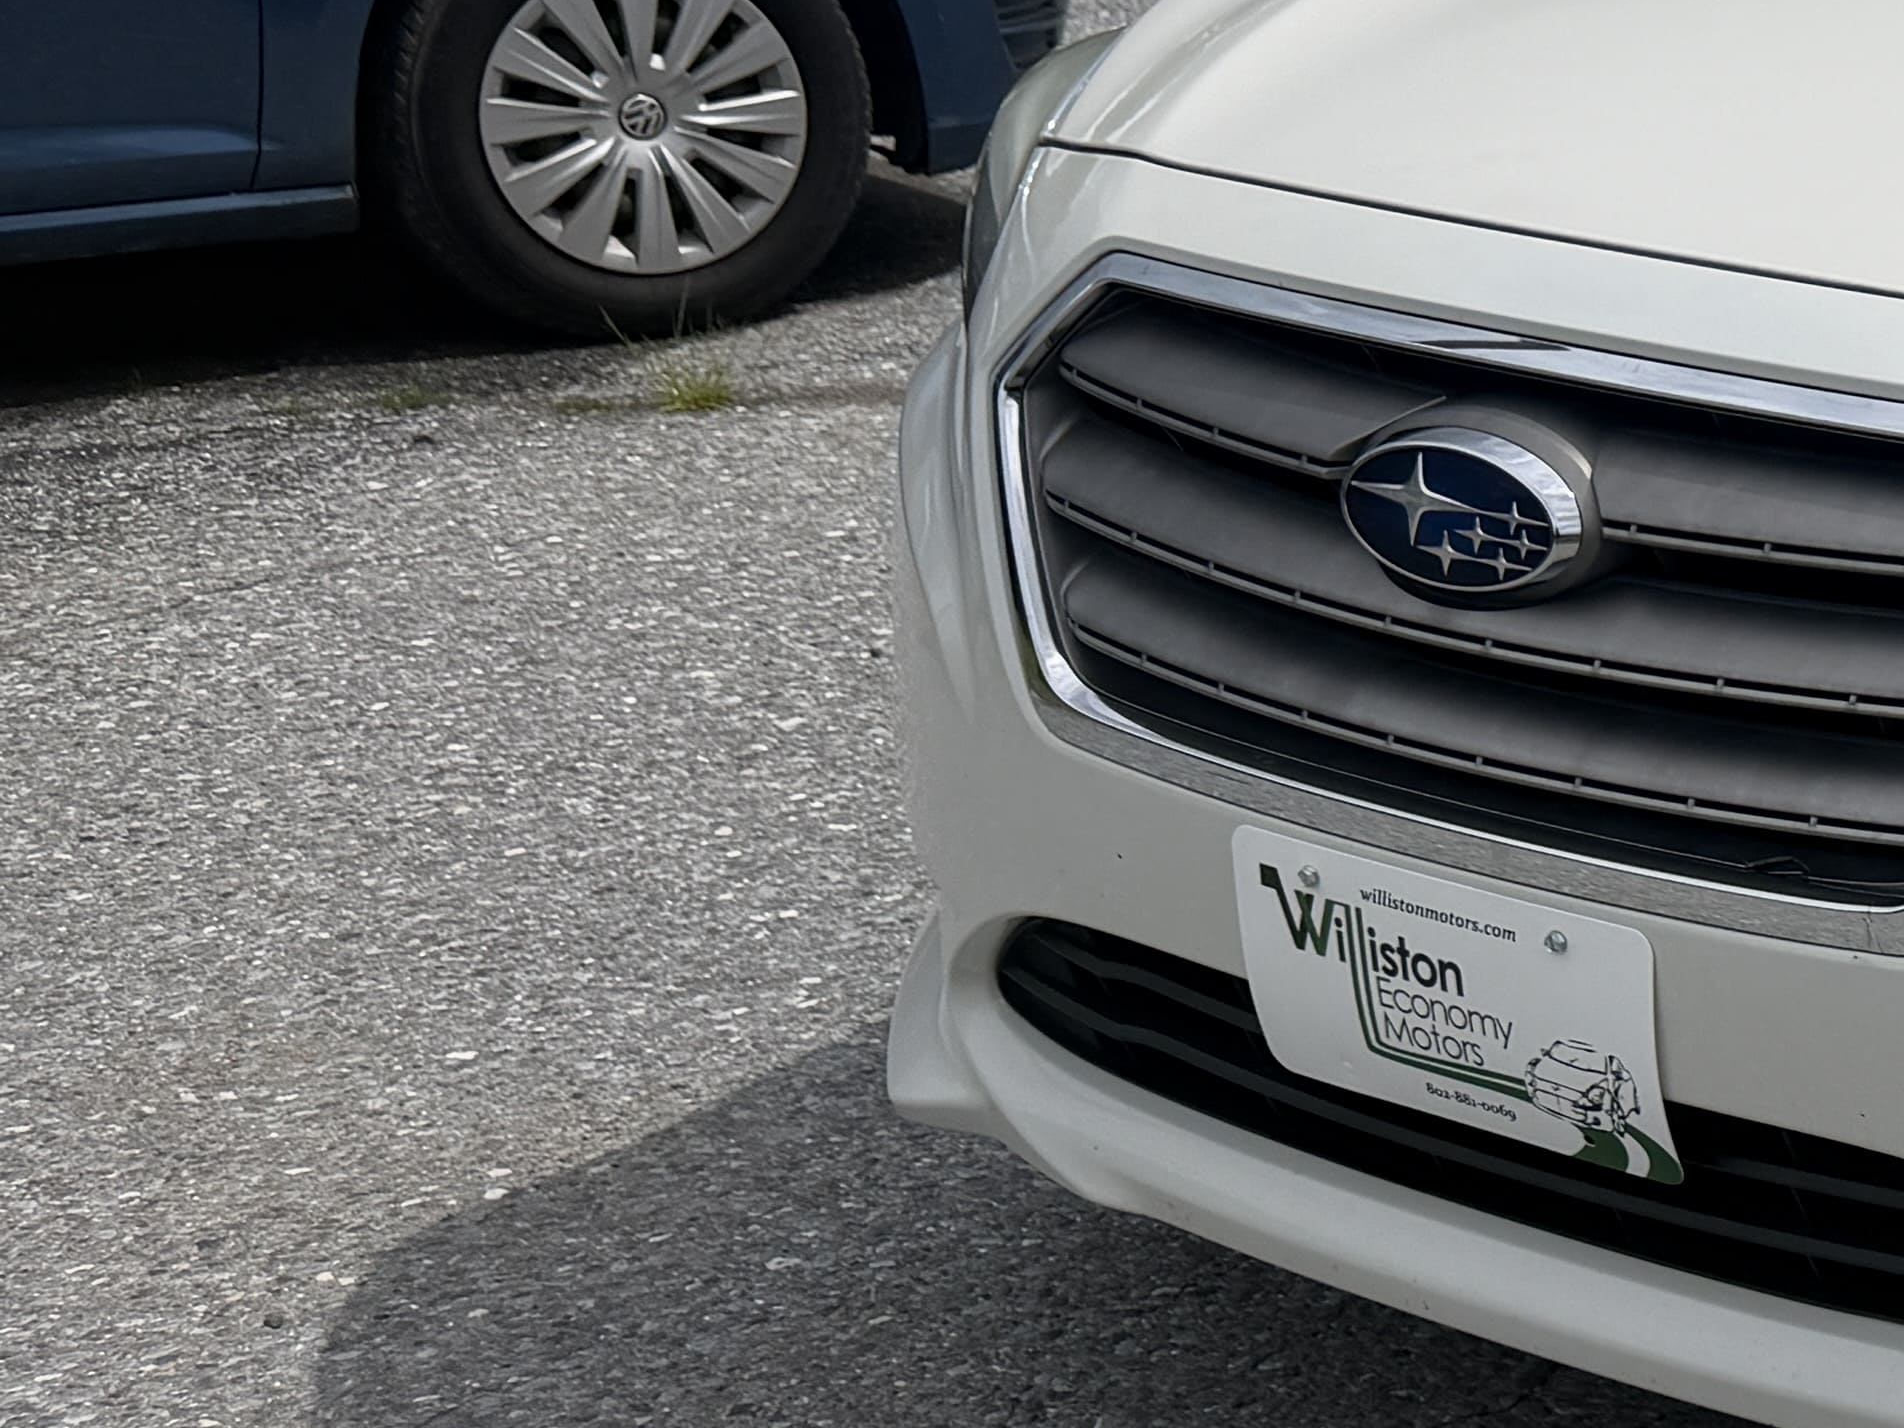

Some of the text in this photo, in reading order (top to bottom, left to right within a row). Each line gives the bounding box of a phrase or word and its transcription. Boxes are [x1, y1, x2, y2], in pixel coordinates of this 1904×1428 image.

[1258, 862, 1465, 997] Williston
[1359, 887, 1518, 943] willistonmotors.com
[1375, 975, 1513, 1050] Economy
[1383, 1010, 1485, 1067] Motors
[1425, 1082, 1518, 1122] 802-881-0069
